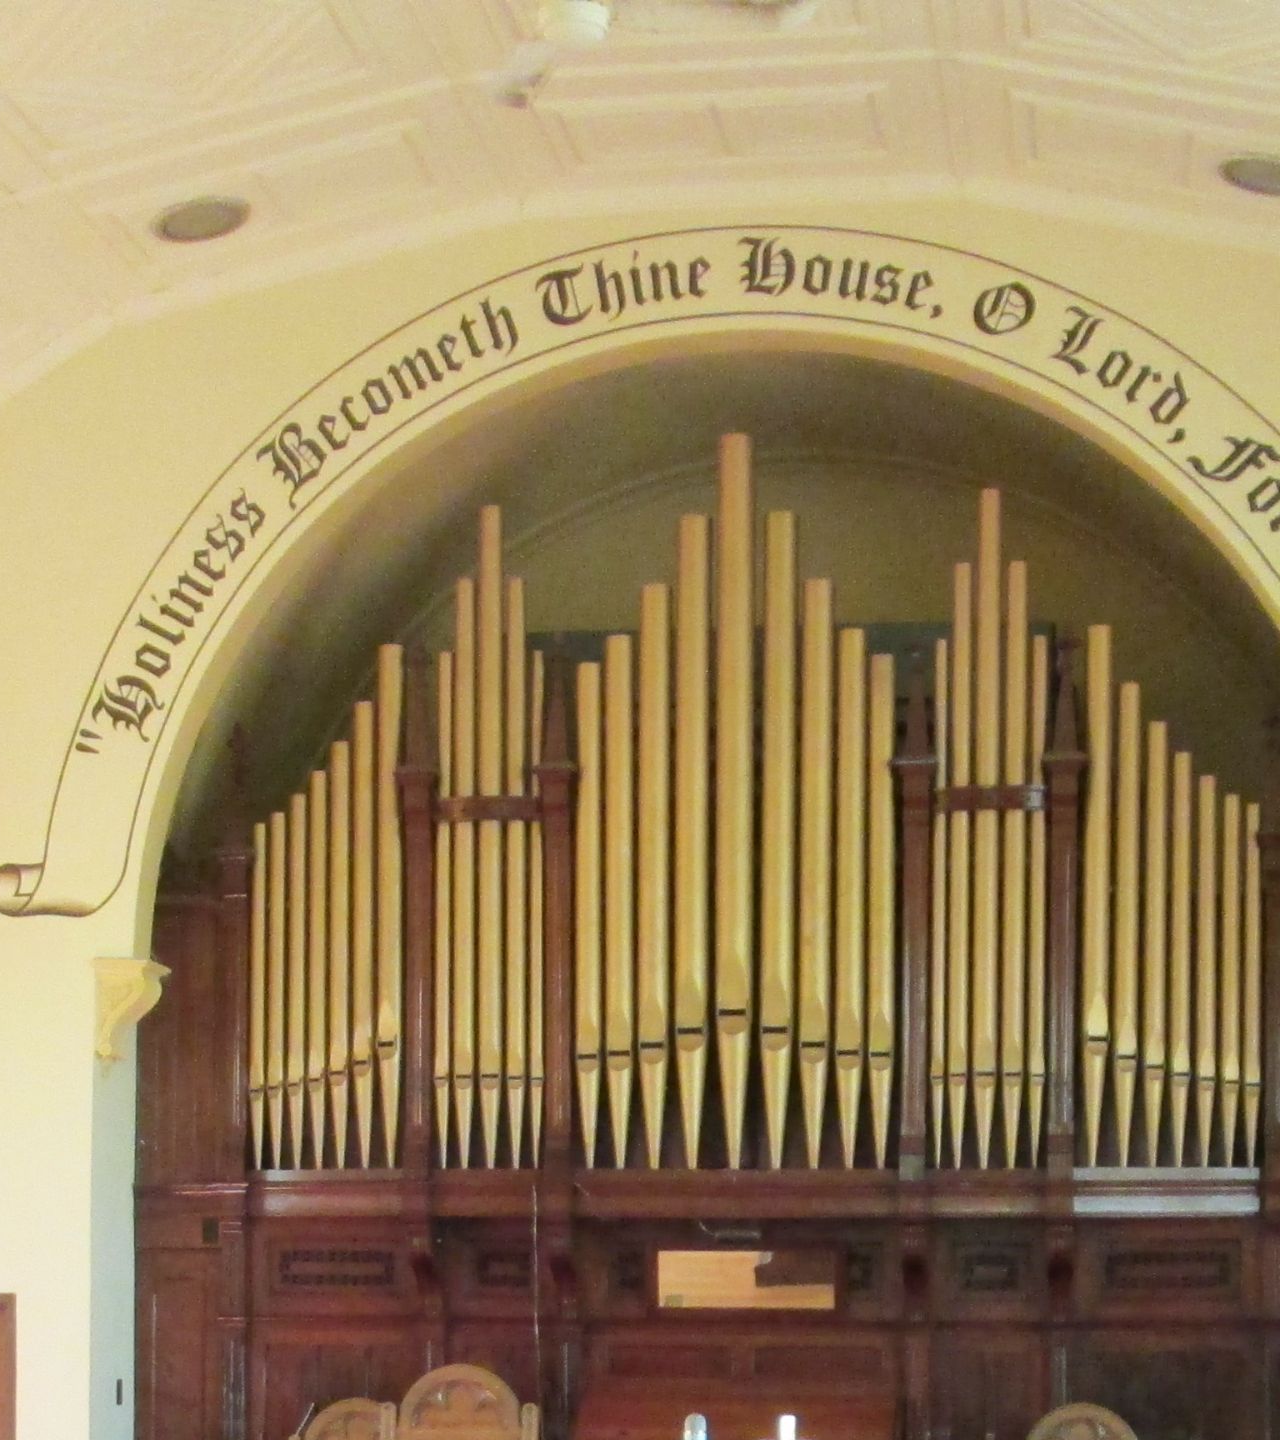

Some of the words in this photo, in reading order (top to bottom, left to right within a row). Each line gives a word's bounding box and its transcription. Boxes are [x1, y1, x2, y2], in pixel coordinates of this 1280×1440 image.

[255, 297, 521, 511] Becometh
[535, 249, 713, 327] Thine
[736, 236, 944, 320] House,
[972, 280, 1037, 336] O
[1050, 305, 1191, 444] Lord,
